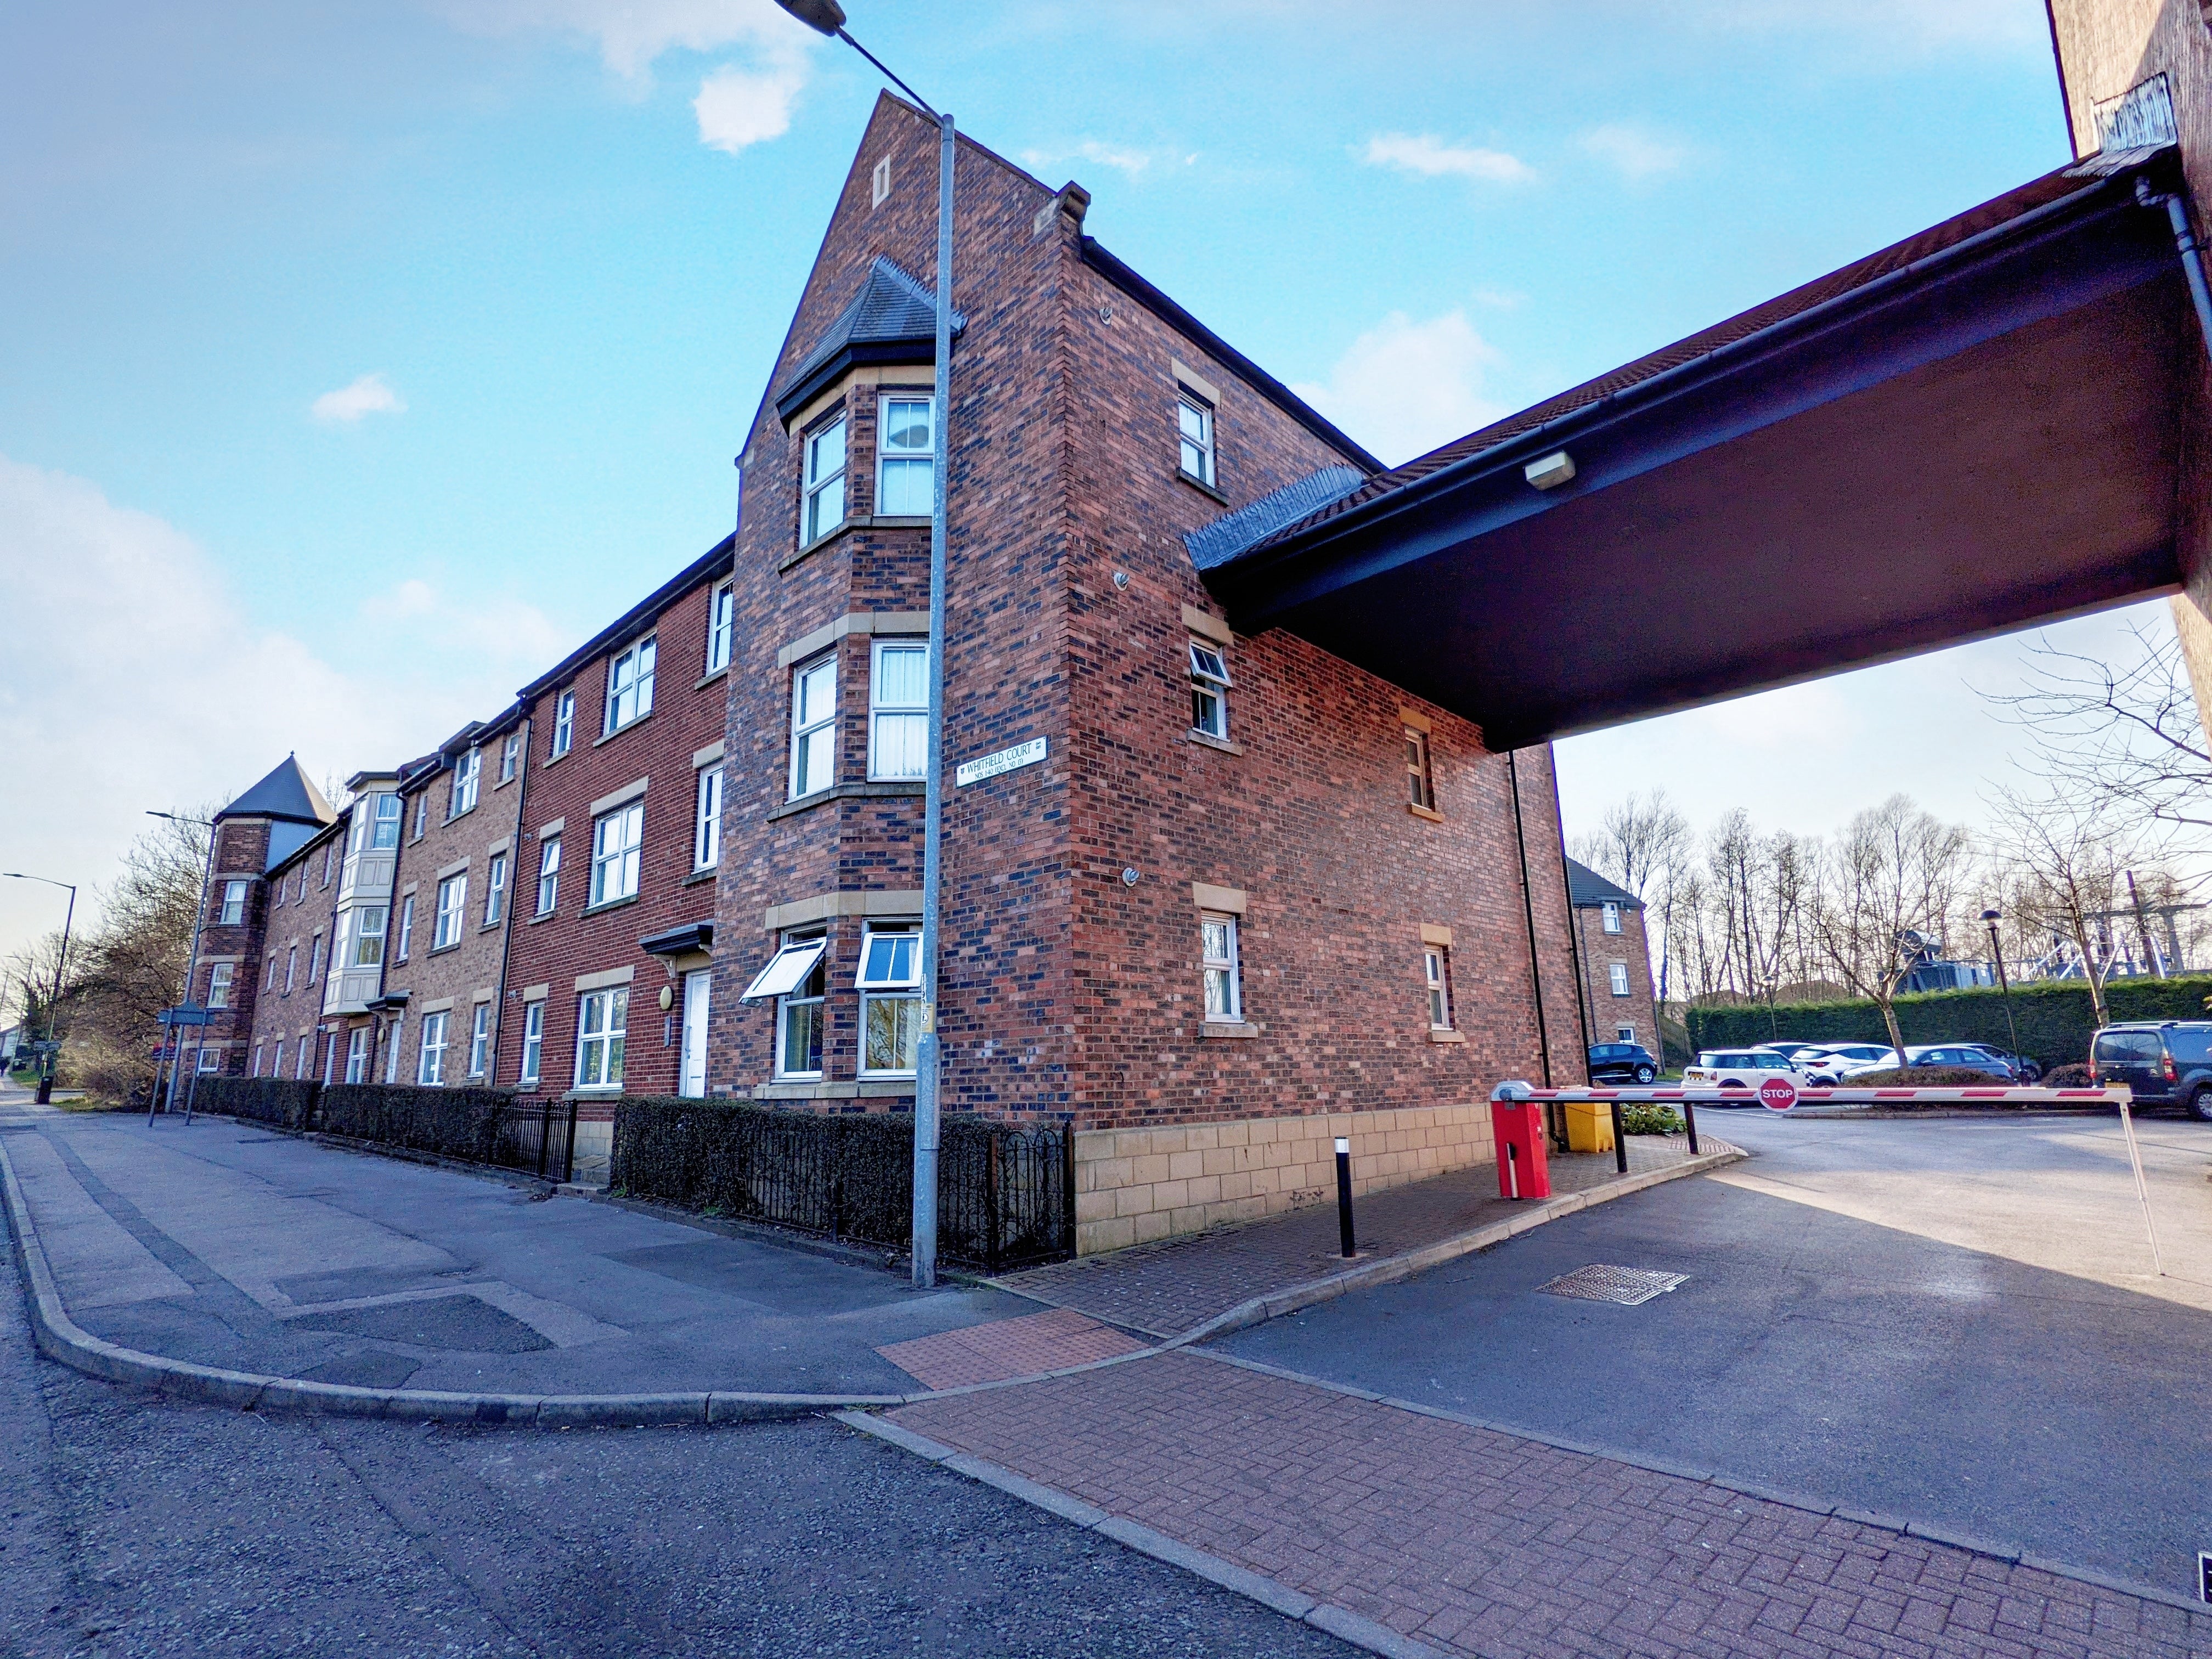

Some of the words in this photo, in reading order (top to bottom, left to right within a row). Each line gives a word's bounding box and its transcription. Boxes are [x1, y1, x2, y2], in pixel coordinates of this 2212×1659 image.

[967, 752, 1003, 774] WHITFIELD
[1007, 743, 1032, 760] COURT
[1762, 1089, 1793, 1098] STOP
